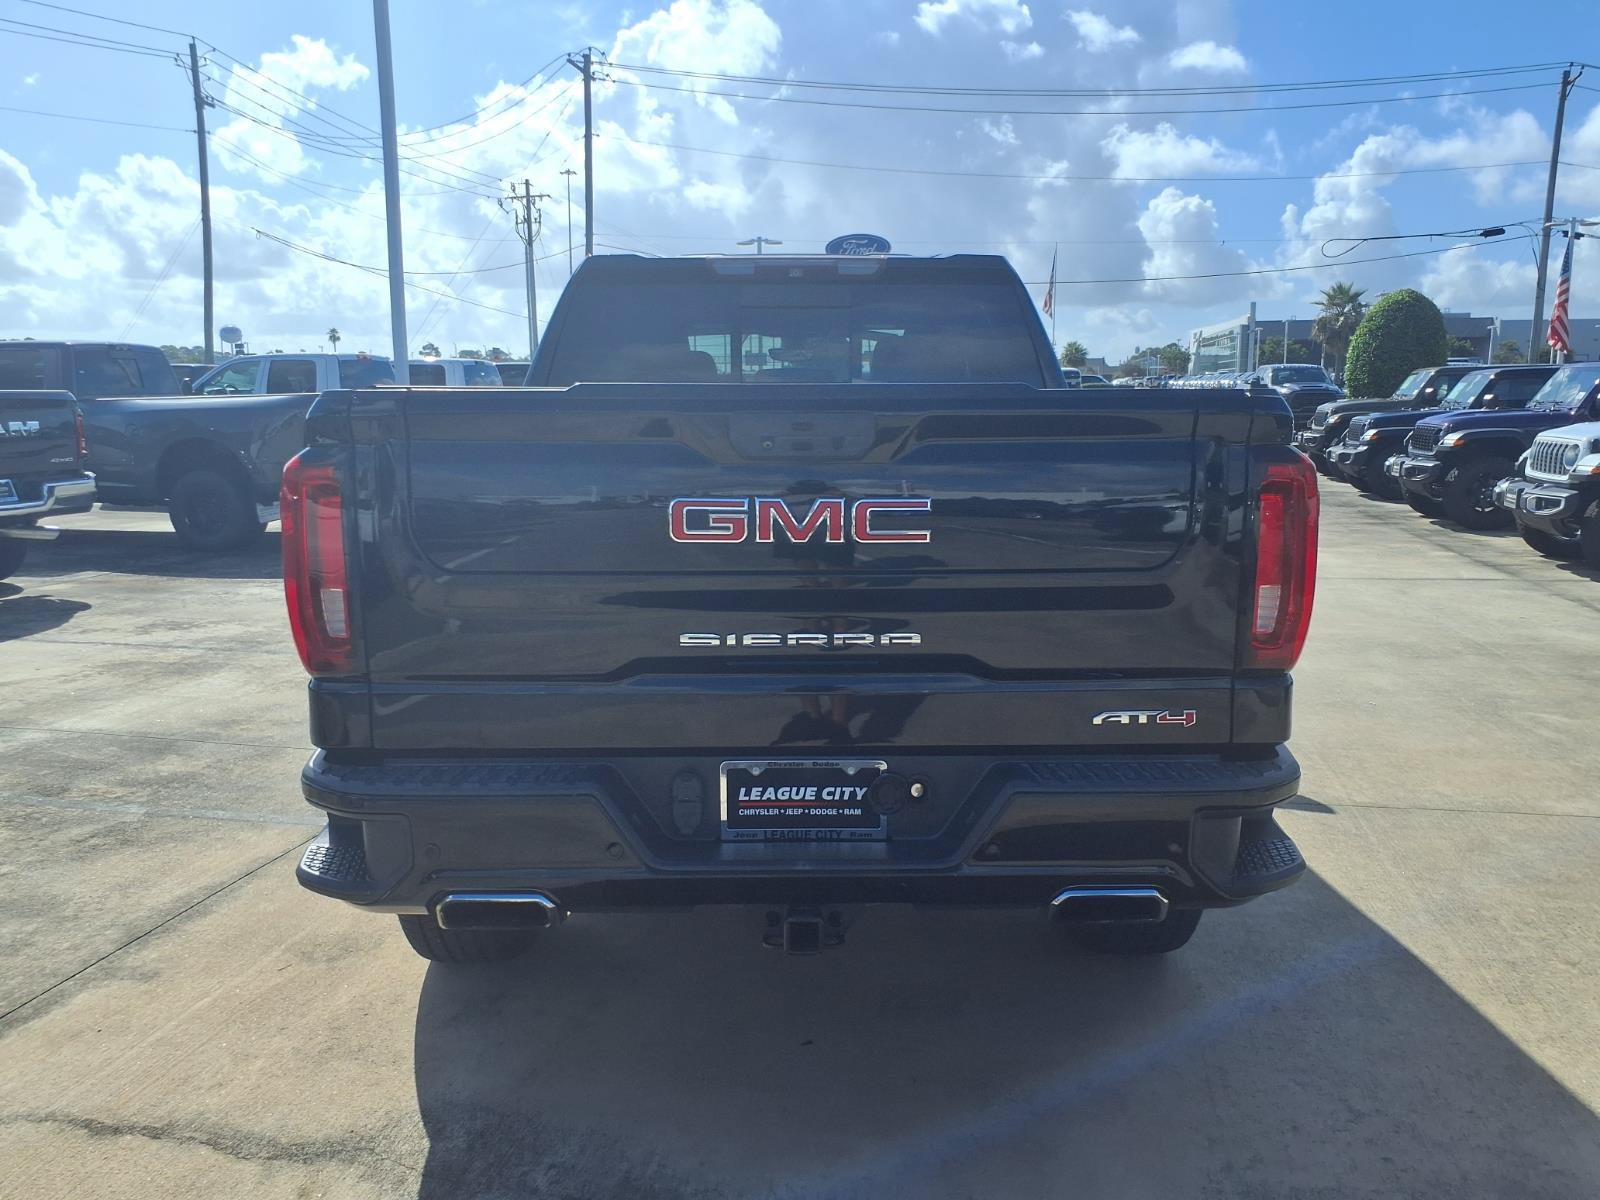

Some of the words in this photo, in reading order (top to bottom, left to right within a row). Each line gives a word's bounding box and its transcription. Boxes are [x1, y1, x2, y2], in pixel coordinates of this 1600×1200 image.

[840, 239, 878, 255] Ford
[668, 497, 932, 544] GMC
[679, 633, 922, 648] SIERRA
[1092, 710, 1196, 727] AT4
[739, 787, 817, 800] LEAGUE
[822, 787, 867, 800] CITY
[763, 830, 814, 840] LEAGUE
[816, 830, 842, 840] CITY
